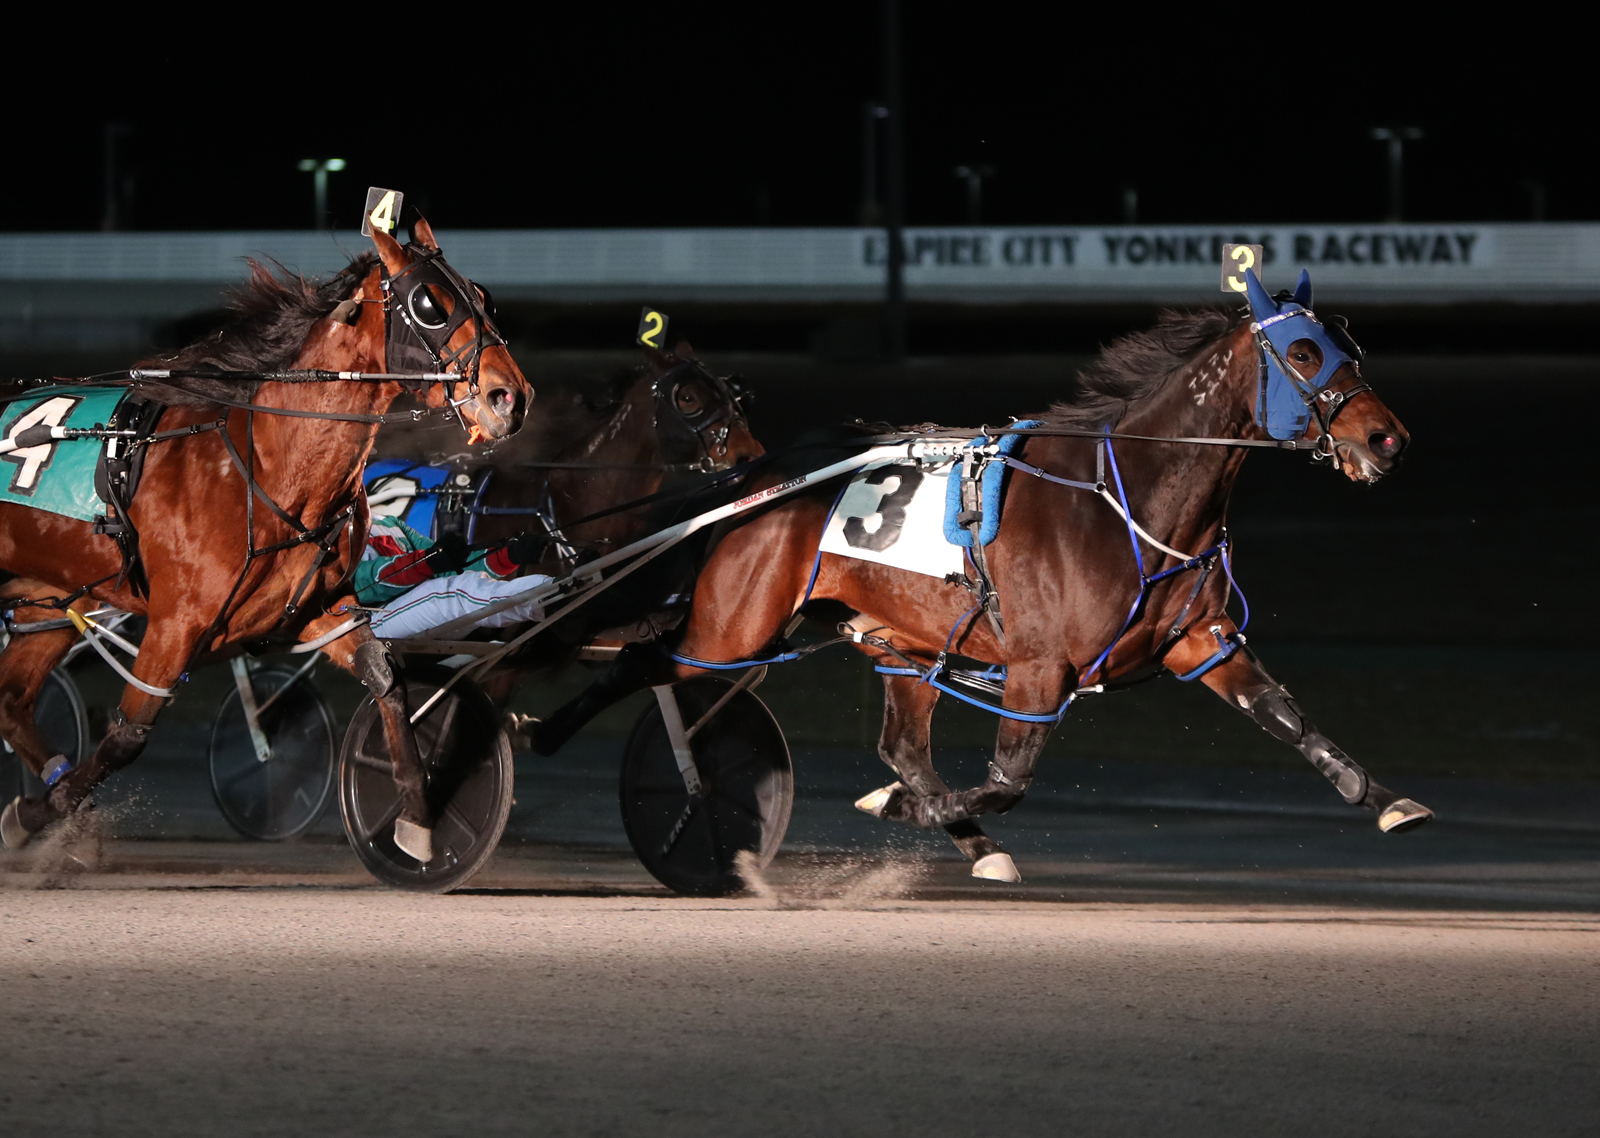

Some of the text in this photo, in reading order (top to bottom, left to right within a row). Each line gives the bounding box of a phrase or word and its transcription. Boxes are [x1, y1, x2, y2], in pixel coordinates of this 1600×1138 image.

[370, 191, 395, 234] 4
[1001, 235, 1079, 267] CITY
[1294, 234, 1479, 265] RACEWAY
[1228, 246, 1255, 292] 3
[641, 311, 663, 348] 2
[3, 395, 82, 494] 4
[843, 466, 924, 552] 3
